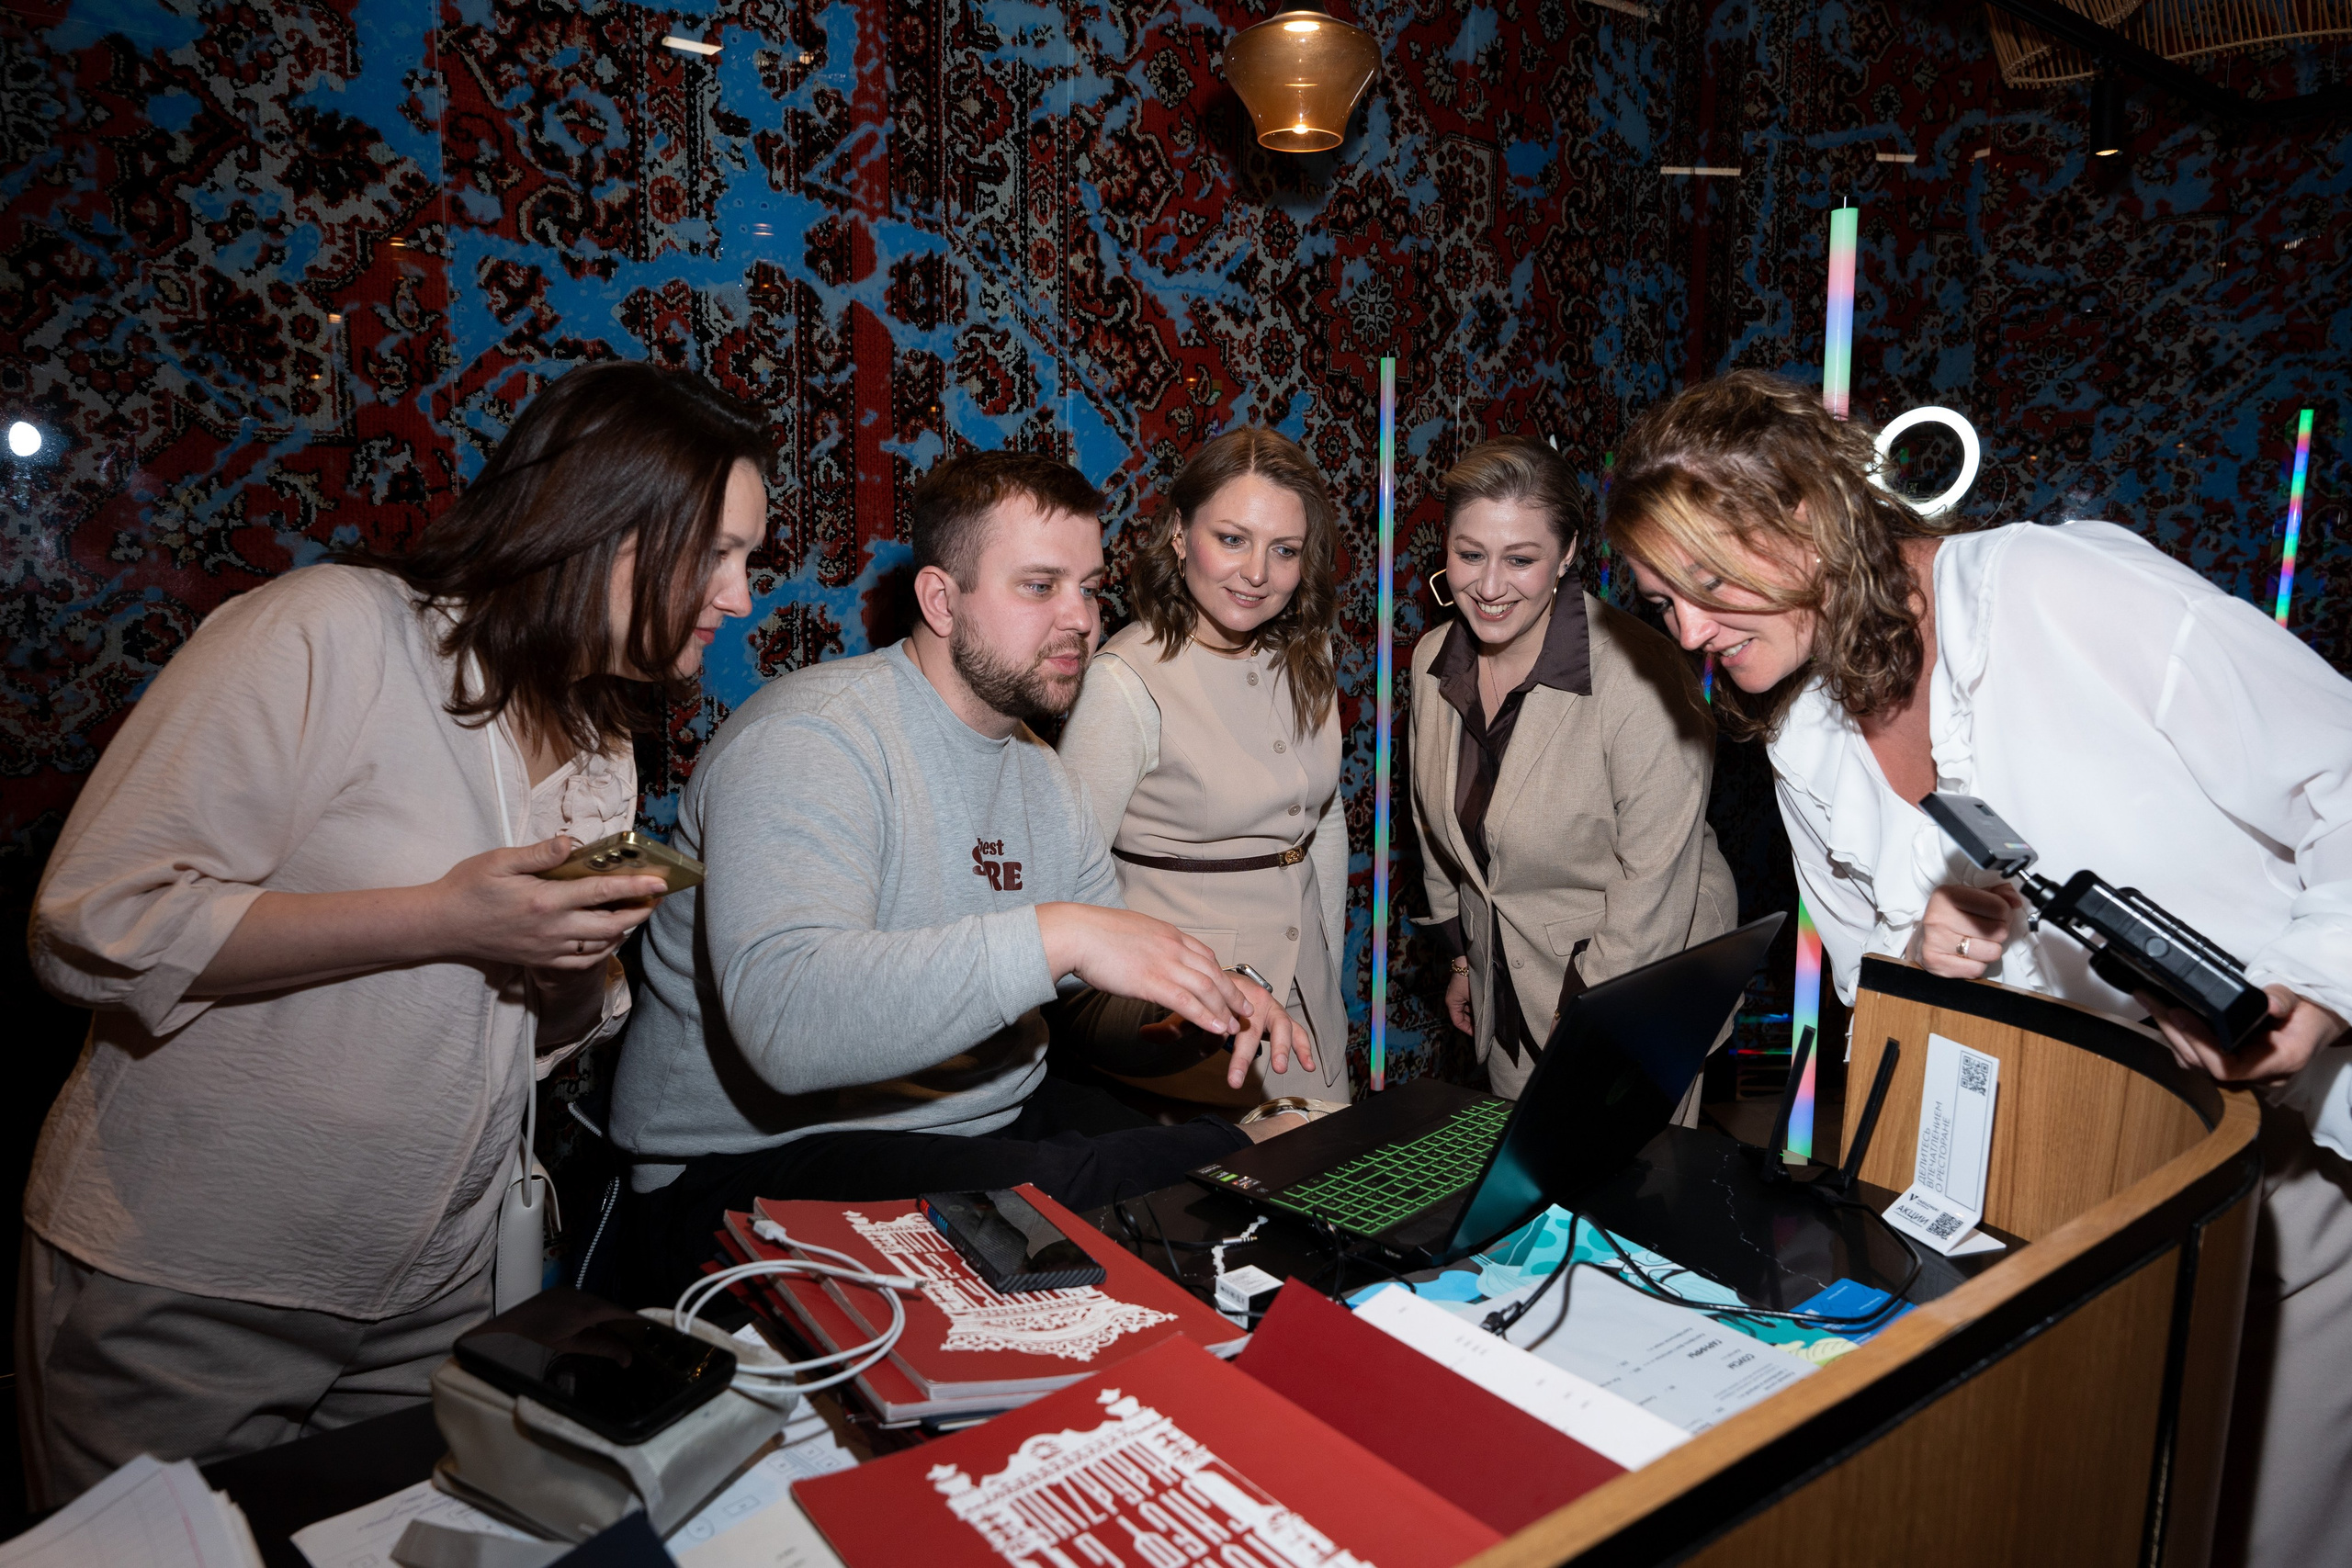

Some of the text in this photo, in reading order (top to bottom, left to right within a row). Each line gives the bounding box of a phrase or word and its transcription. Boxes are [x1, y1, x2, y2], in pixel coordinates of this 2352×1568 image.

[1917, 1127, 1930, 1186] ДЕЛИТЕСЬ
[1927, 1101, 1942, 1189] ВПЕЧАТЛЕНИЕМ
[1937, 1117, 1951, 1182] РЕСТОРАНЕ
[1896, 1204, 1929, 1225] АКЦИИ
